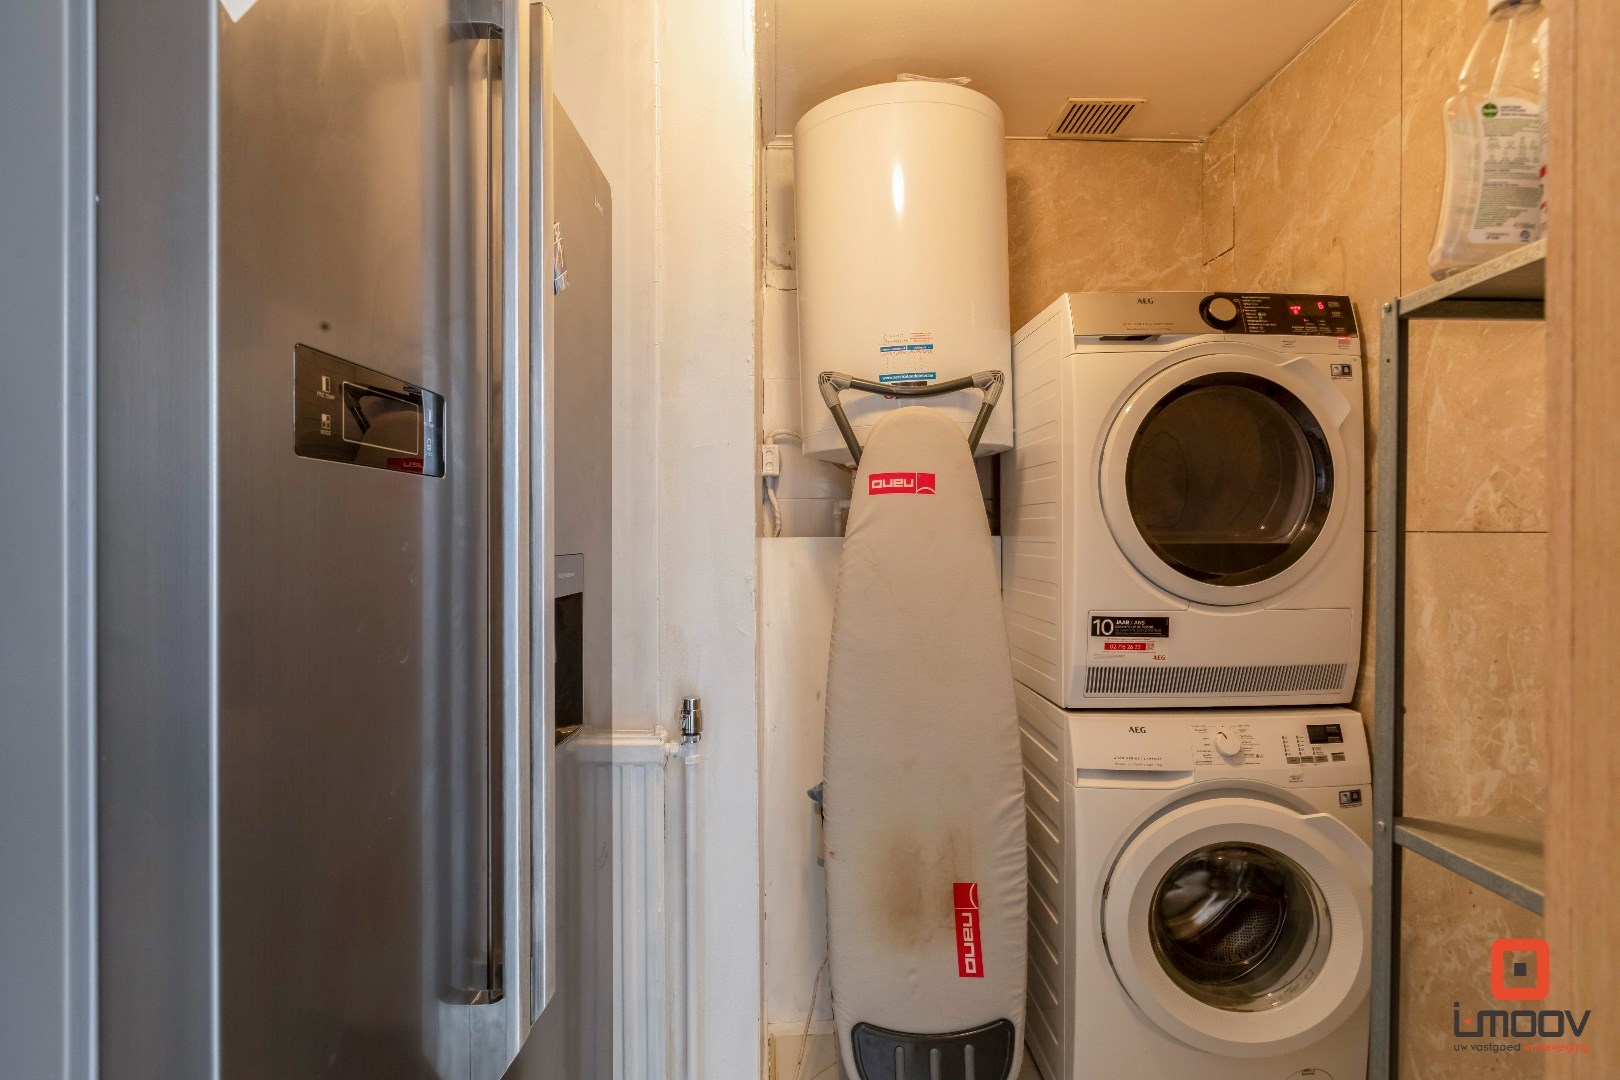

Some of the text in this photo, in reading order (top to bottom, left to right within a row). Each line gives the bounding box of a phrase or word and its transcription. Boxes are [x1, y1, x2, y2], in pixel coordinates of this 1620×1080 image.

[871, 478, 914, 489] nano
[1092, 618, 1114, 636] 10
[1128, 726, 1147, 734] AEG
[961, 912, 977, 974] nano
